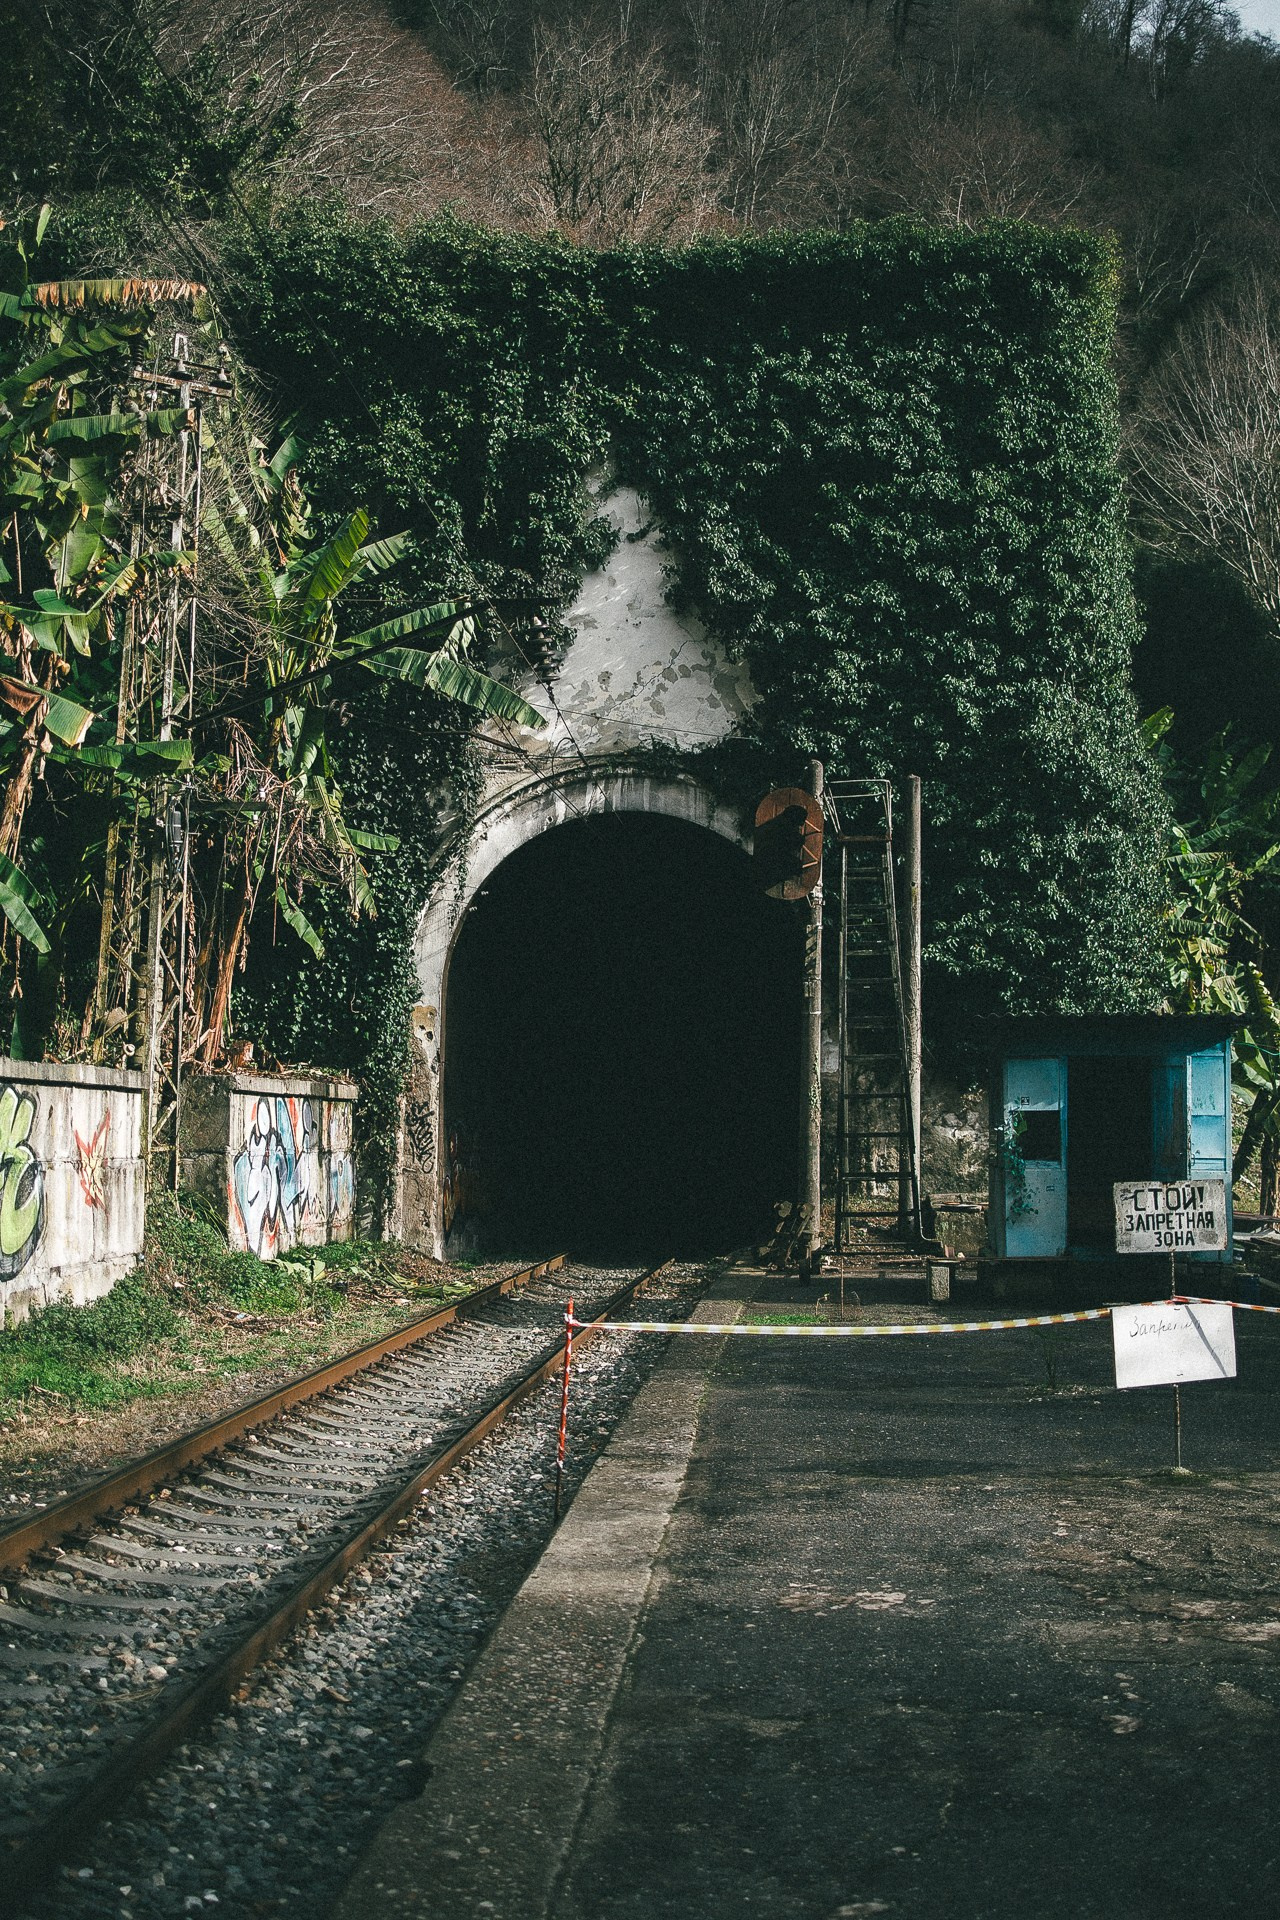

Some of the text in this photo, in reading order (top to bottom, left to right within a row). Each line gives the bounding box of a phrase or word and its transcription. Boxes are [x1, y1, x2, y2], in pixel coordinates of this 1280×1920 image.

[1133, 1184, 1205, 1212] СТОЙ!
[1125, 1211, 1215, 1232] ЗАПРЕТНАЯ
[1154, 1230, 1196, 1247] ЗОНА
